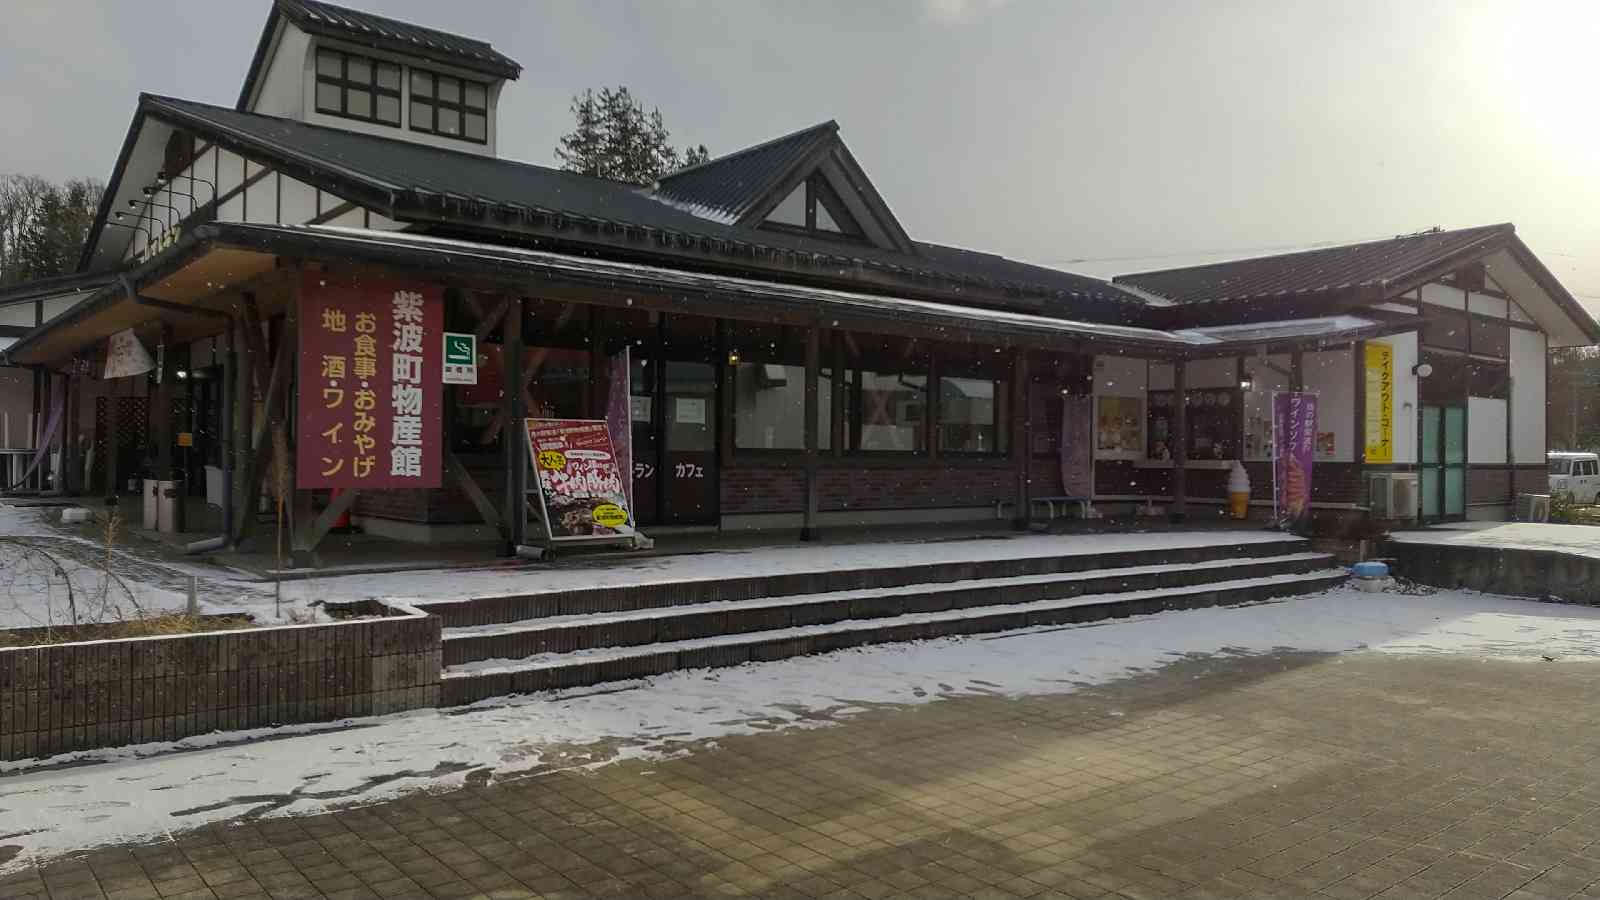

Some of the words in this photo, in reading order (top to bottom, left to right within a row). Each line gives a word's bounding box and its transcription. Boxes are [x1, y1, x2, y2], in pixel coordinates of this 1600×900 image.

[353, 312, 376, 478] お食事・おみやげ
[391, 290, 424, 477] 紫波町物産館
[675, 463, 704, 478] カフェ
